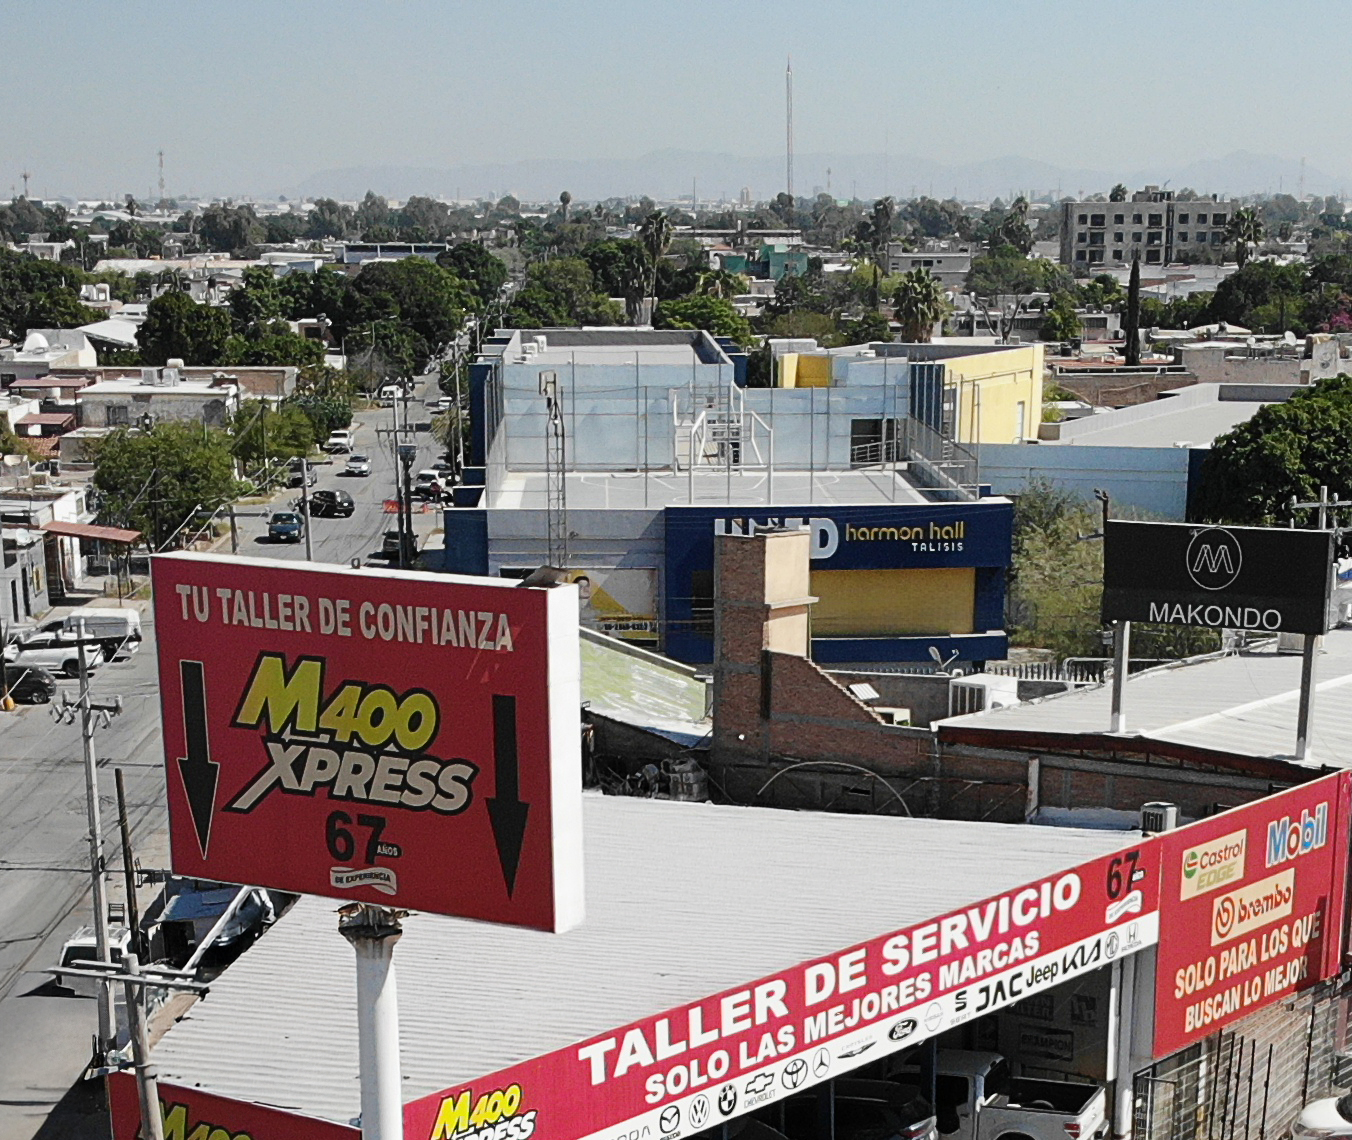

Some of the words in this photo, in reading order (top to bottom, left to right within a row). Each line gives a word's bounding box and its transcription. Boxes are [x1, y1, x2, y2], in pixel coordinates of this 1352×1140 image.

[846, 522, 924, 541] harmon
[929, 521, 964, 540] hall
[911, 542, 964, 552] TALISIS
[175, 583, 209, 622] TU
[216, 588, 312, 633] TALLER
[318, 597, 352, 637] DE
[359, 601, 514, 651] CONFIANZA
[1149, 602, 1282, 630] MAKONDO
[230, 741, 475, 812] XPRESS
[326, 810, 386, 864] 67
[1199, 838, 1244, 870] Castrol
[1266, 801, 1328, 868] Mobil
[1107, 850, 1140, 900] 67
[1197, 861, 1237, 891] EDGE
[1238, 884, 1291, 924] brembo
[1026, 954, 1058, 988] Jeep
[1062, 937, 1101, 975] KIA
[1174, 956, 1216, 999] SOLO
[1219, 938, 1257, 981] PARA
[1261, 924, 1289, 962] LOS
[1291, 911, 1321, 948] QUE
[578, 979, 789, 1086] TALLER
[805, 949, 867, 1007] DE
[881, 873, 1082, 975] SERVICIO
[975, 972, 1023, 1013] JAC
[1184, 984, 1241, 1033] BUSCAN
[1243, 976, 1261, 1006] LO
[1264, 955, 1308, 998] MEJOR
[645, 1050, 730, 1104] SOLO
[739, 1024, 796, 1069] LAS
[803, 972, 932, 1044] MEJORES
[939, 930, 1040, 991] MARCAS
